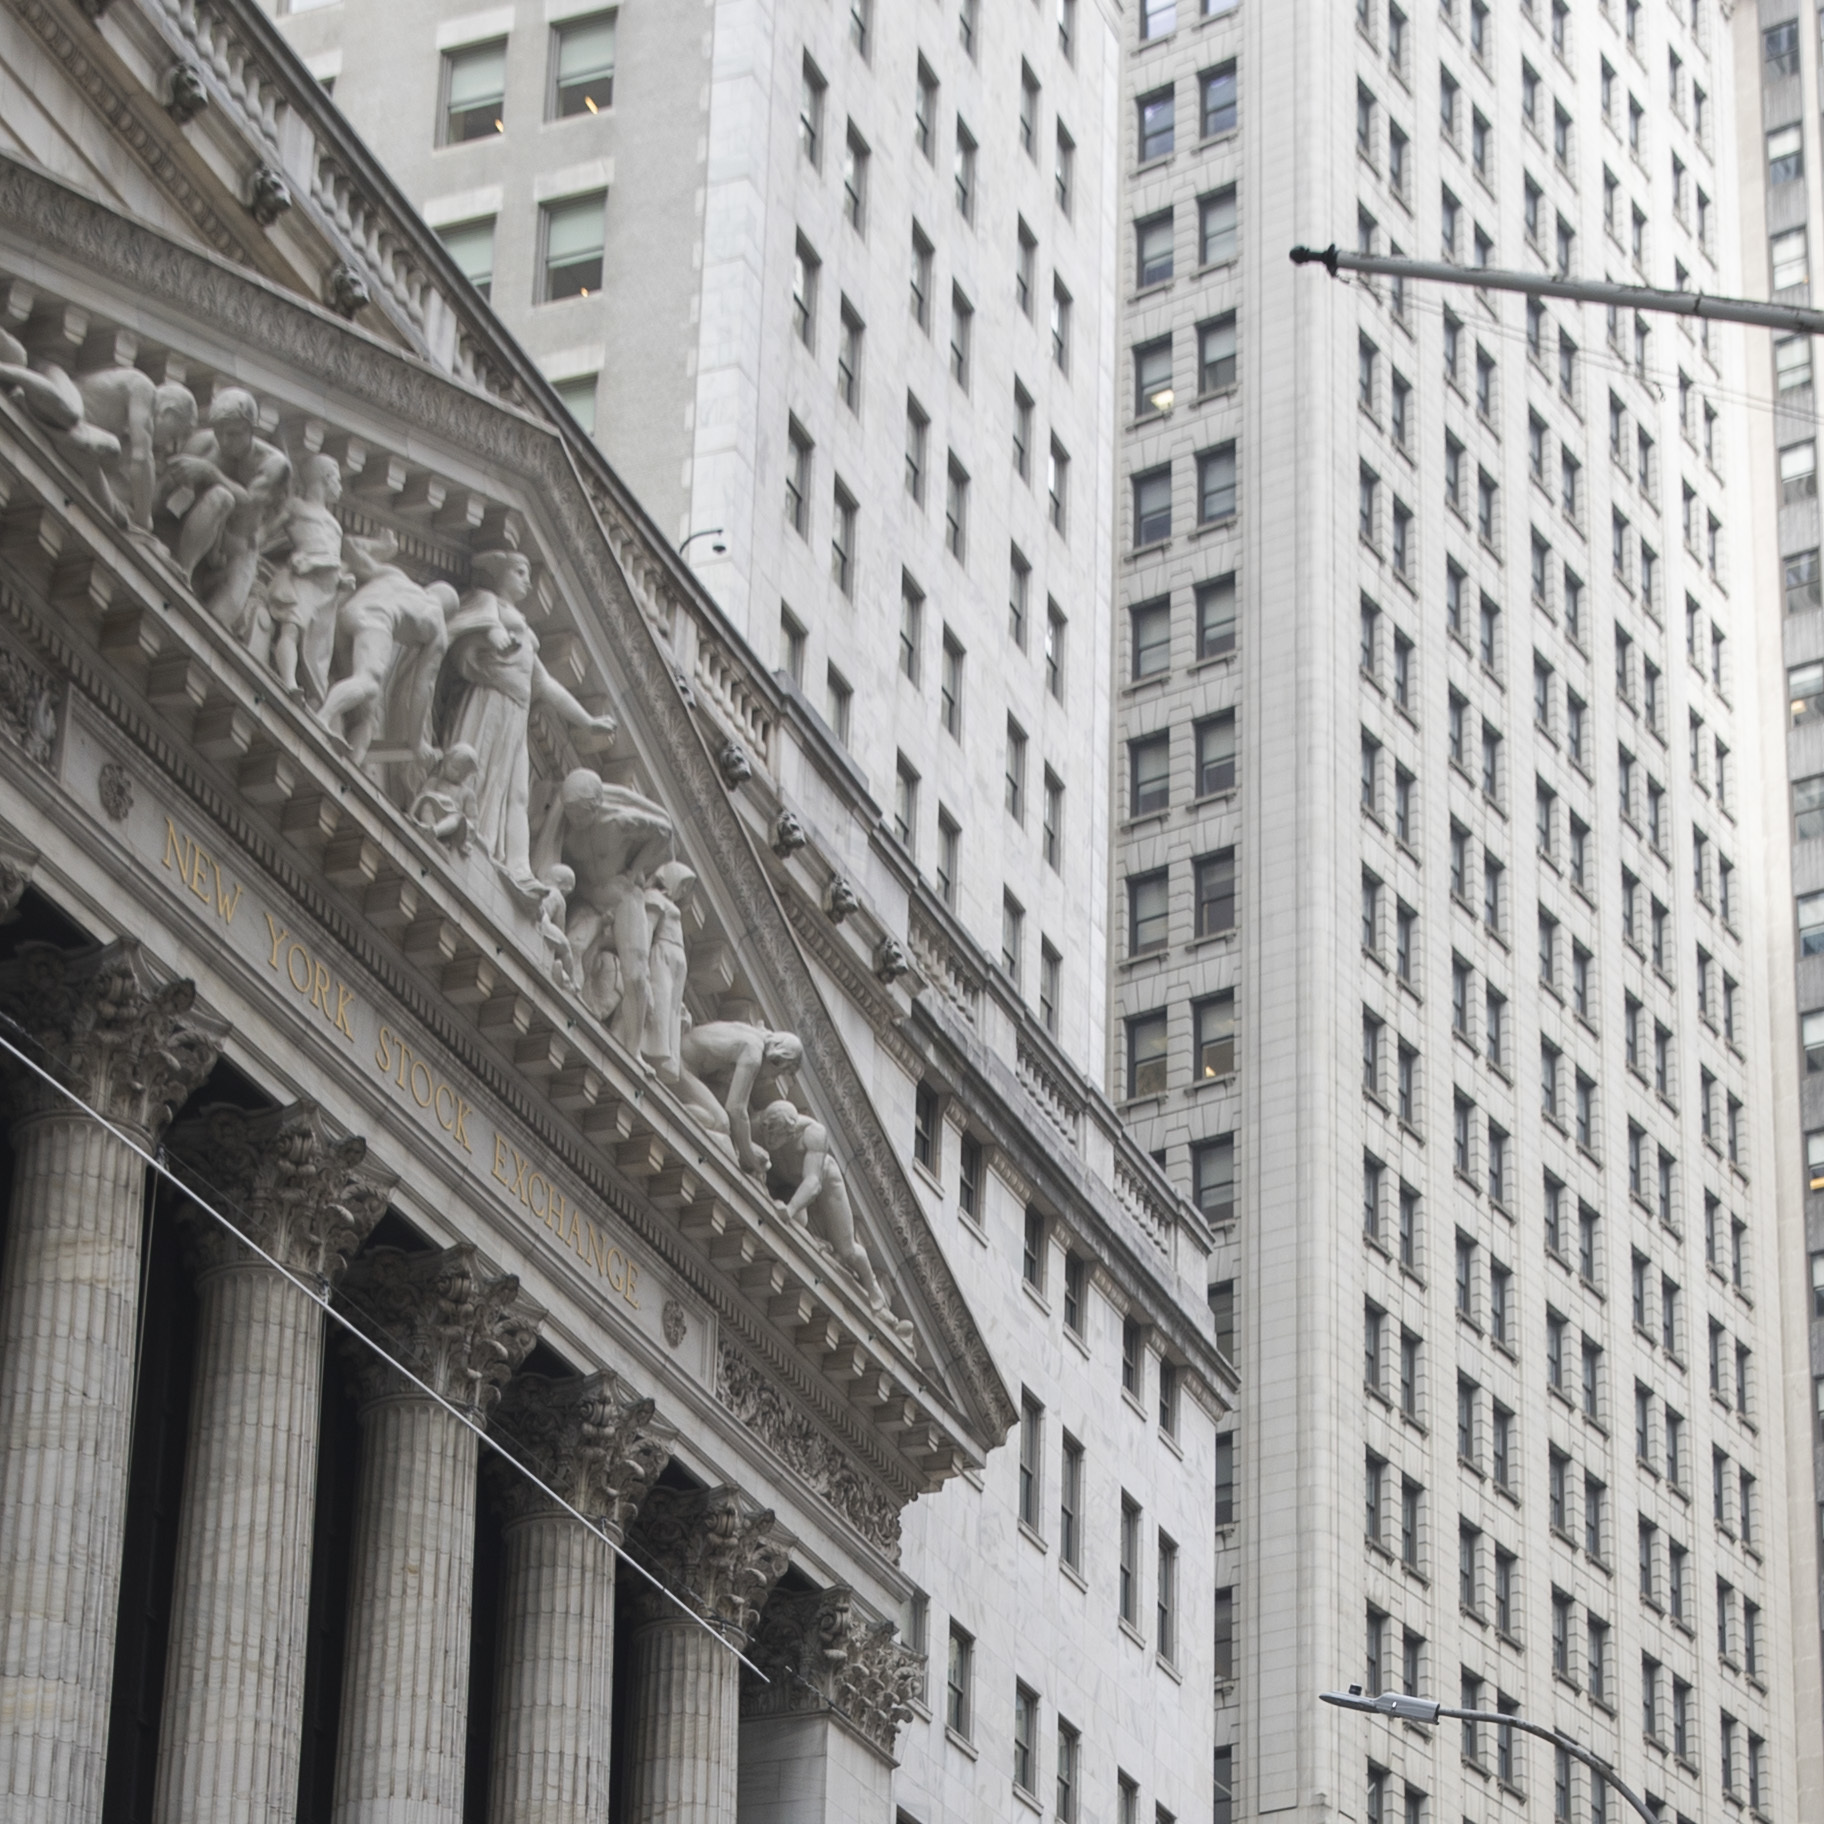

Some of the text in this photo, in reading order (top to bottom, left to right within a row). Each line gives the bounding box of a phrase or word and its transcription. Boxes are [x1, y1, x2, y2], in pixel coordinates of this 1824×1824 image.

[162, 816, 643, 1310] NEW YORK STOCK EXCHANGE
